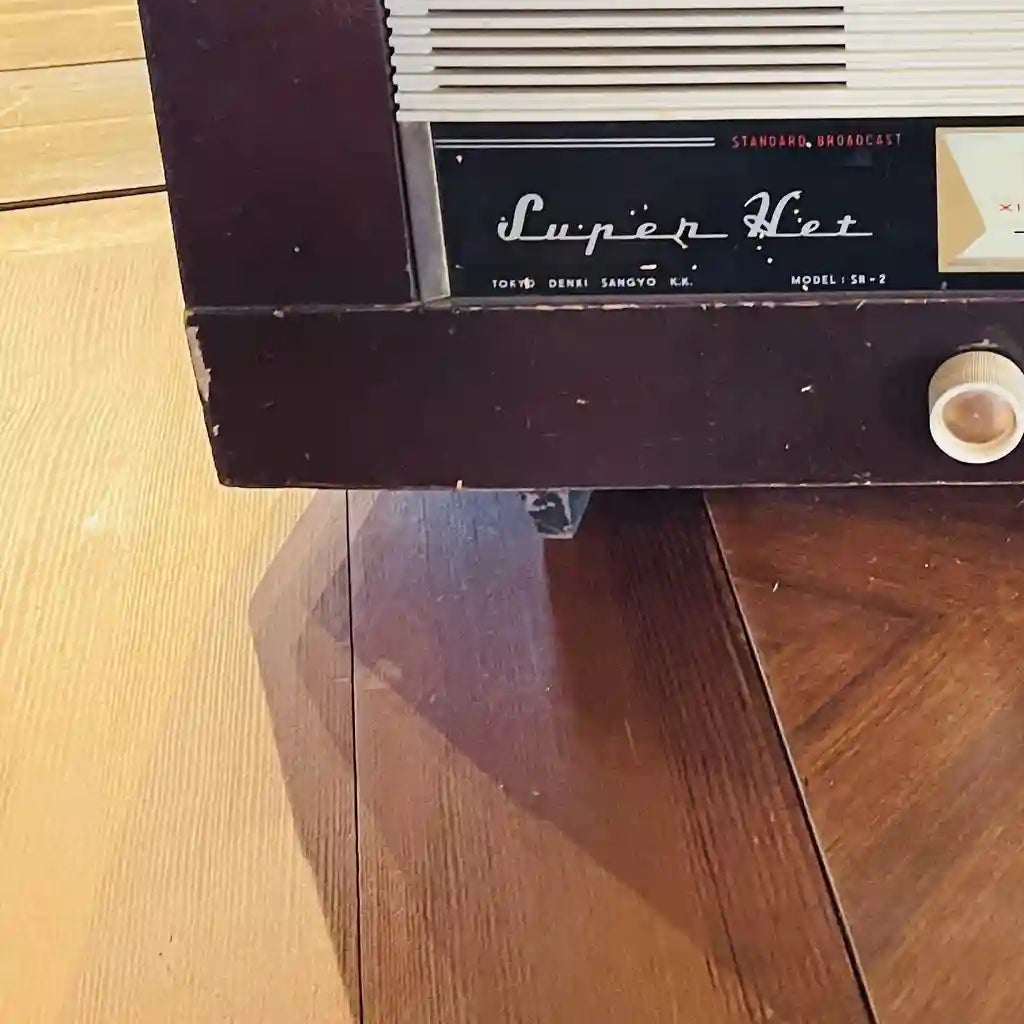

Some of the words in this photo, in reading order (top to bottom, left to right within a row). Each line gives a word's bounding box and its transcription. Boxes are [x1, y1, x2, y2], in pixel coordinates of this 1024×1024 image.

[731, 135, 807, 148] STANDARD
[816, 132, 901, 147] BROADCAST
[497, 192, 729, 256] Super
[743, 189, 874, 239] Het
[492, 278, 536, 289] TOKYO
[548, 278, 588, 289] DENKI
[601, 277, 657, 288] SANGYO
[791, 275, 837, 285] MODEL
